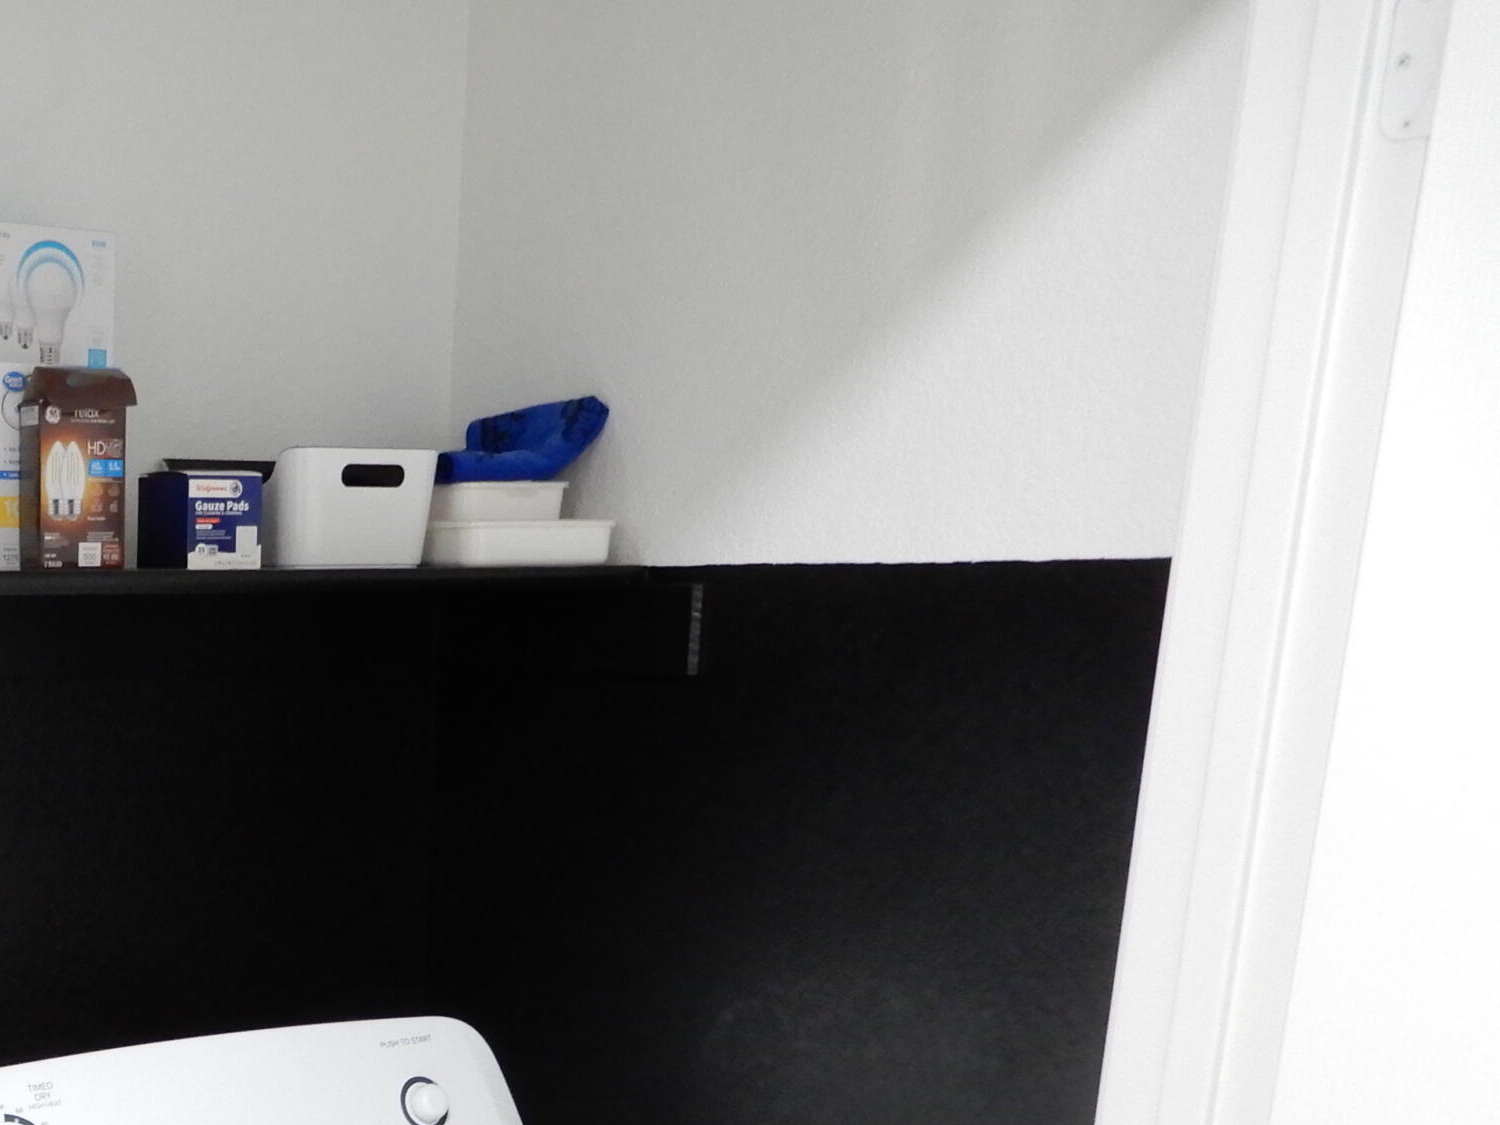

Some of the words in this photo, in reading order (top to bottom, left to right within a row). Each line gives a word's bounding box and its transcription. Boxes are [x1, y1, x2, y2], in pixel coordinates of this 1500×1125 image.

[87, 441, 106, 456] HD
[195, 500, 226, 512] Gauze
[227, 500, 250, 512] Pads
[400, 1038, 410, 1046] TO
[411, 1034, 432, 1044] START
[27, 1081, 53, 1092] TIMED
[34, 1091, 51, 1101] DRY
